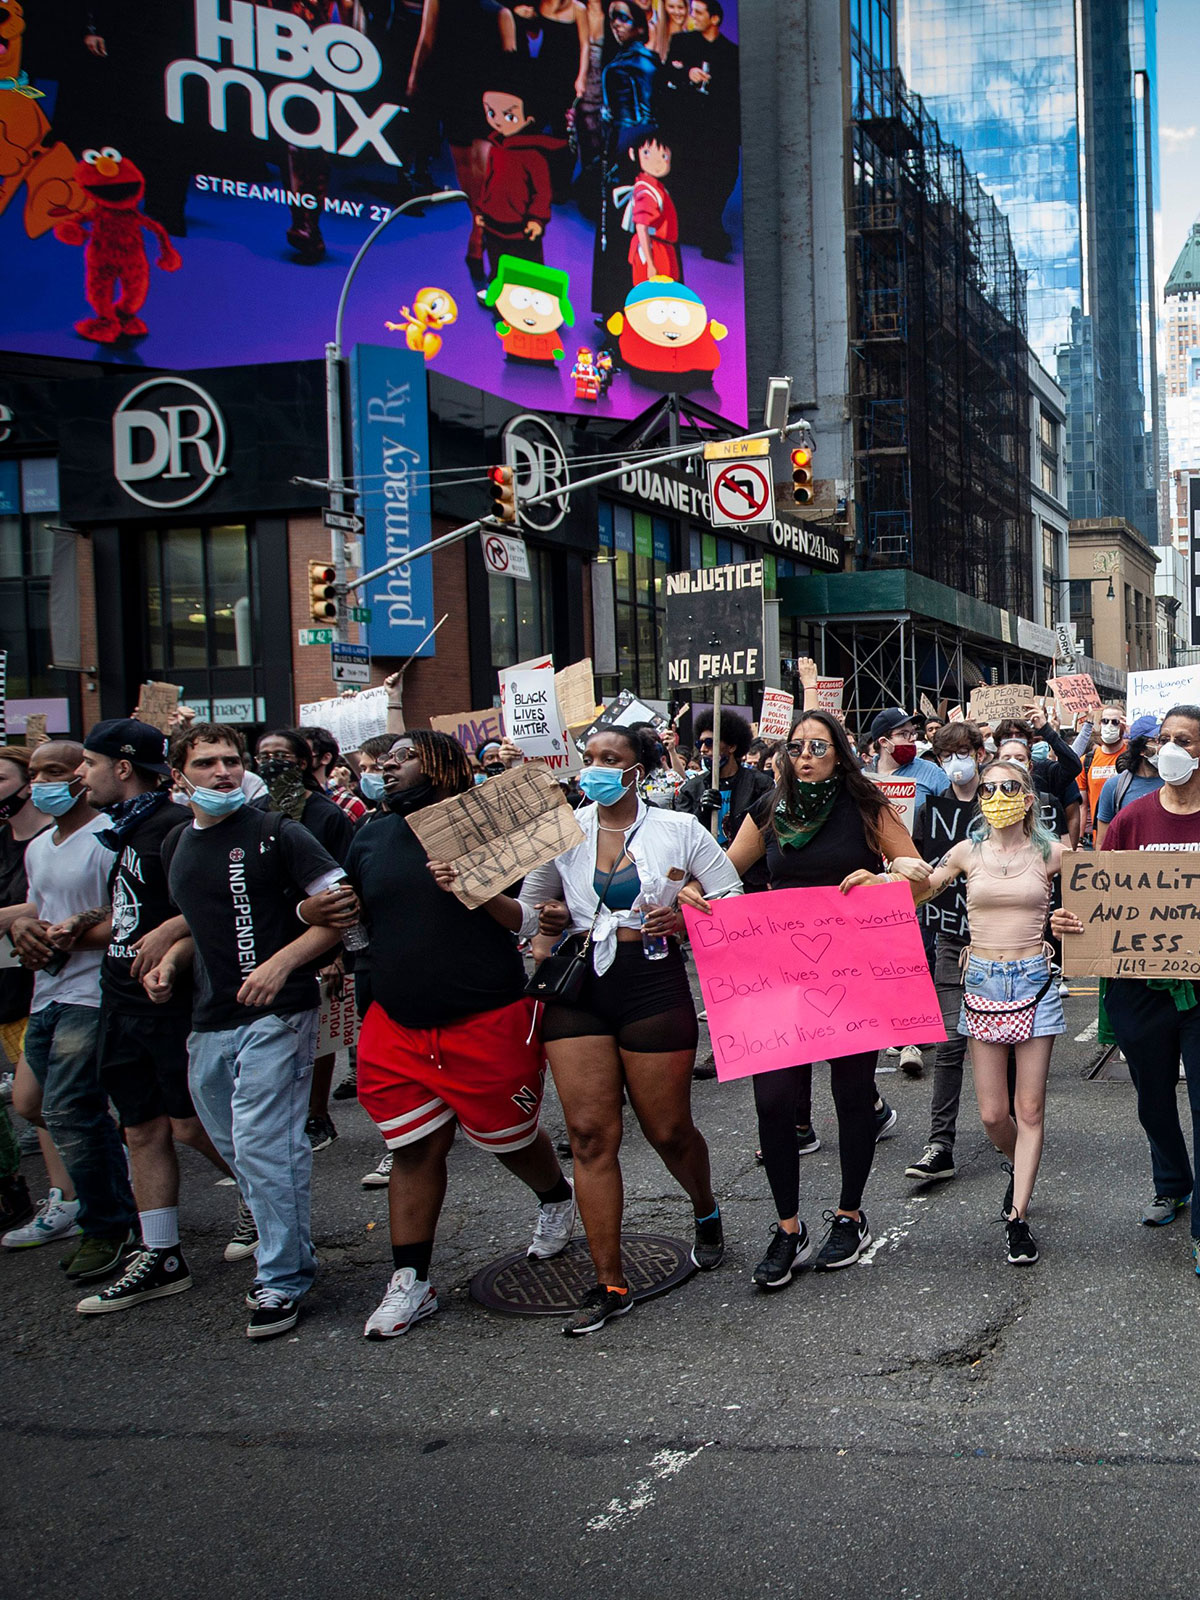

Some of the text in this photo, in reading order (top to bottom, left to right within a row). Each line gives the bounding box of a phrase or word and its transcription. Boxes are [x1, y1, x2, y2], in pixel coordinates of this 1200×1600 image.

[195, 0, 383, 92] HBO
[165, 58, 407, 167] max
[195, 173, 392, 222] STREAMING MAY 27
[368, 381, 410, 426] Rx
[113, 405, 227, 482] DR
[724, 443, 749, 454] NEW
[504, 429, 571, 516] DR
[373, 436, 426, 628] pharmacy
[772, 520, 808, 554] OPEN
[667, 562, 763, 596] NO JUSTICE
[316, 630, 326, 642] 42
[1057, 626, 1075, 672] MORMN
[668, 648, 758, 683] NO PEACE
[975, 686, 1031, 701] THE PEOPLE
[1056, 677, 1092, 689] PLICE
[1058, 686, 1096, 699] BRUTALITY
[1134, 677, 1193, 697] Headbanger
[514, 690, 548, 705] BLACK
[984, 697, 1016, 708] UNITED
[194, 703, 250, 720] armacy
[301, 704, 324, 716] SAY
[514, 708, 545, 721] LIVES
[768, 711, 787, 719] POLICE
[977, 706, 999, 716] WILL
[1131, 706, 1166, 720] Black
[513, 722, 550, 737] MATTER
[880, 785, 916, 797] EMAND
[229, 863, 257, 981] INDEPENDEN
[926, 903, 970, 937] PEA
[1089, 902, 1140, 924] AND
[695, 907, 917, 949] Black lives are worthy
[708, 958, 930, 1005] Black lives are beloved
[321, 1013, 328, 1024] TO
[343, 977, 355, 1046] BRUTALITY
[717, 1010, 943, 1065] Black lives are needed
